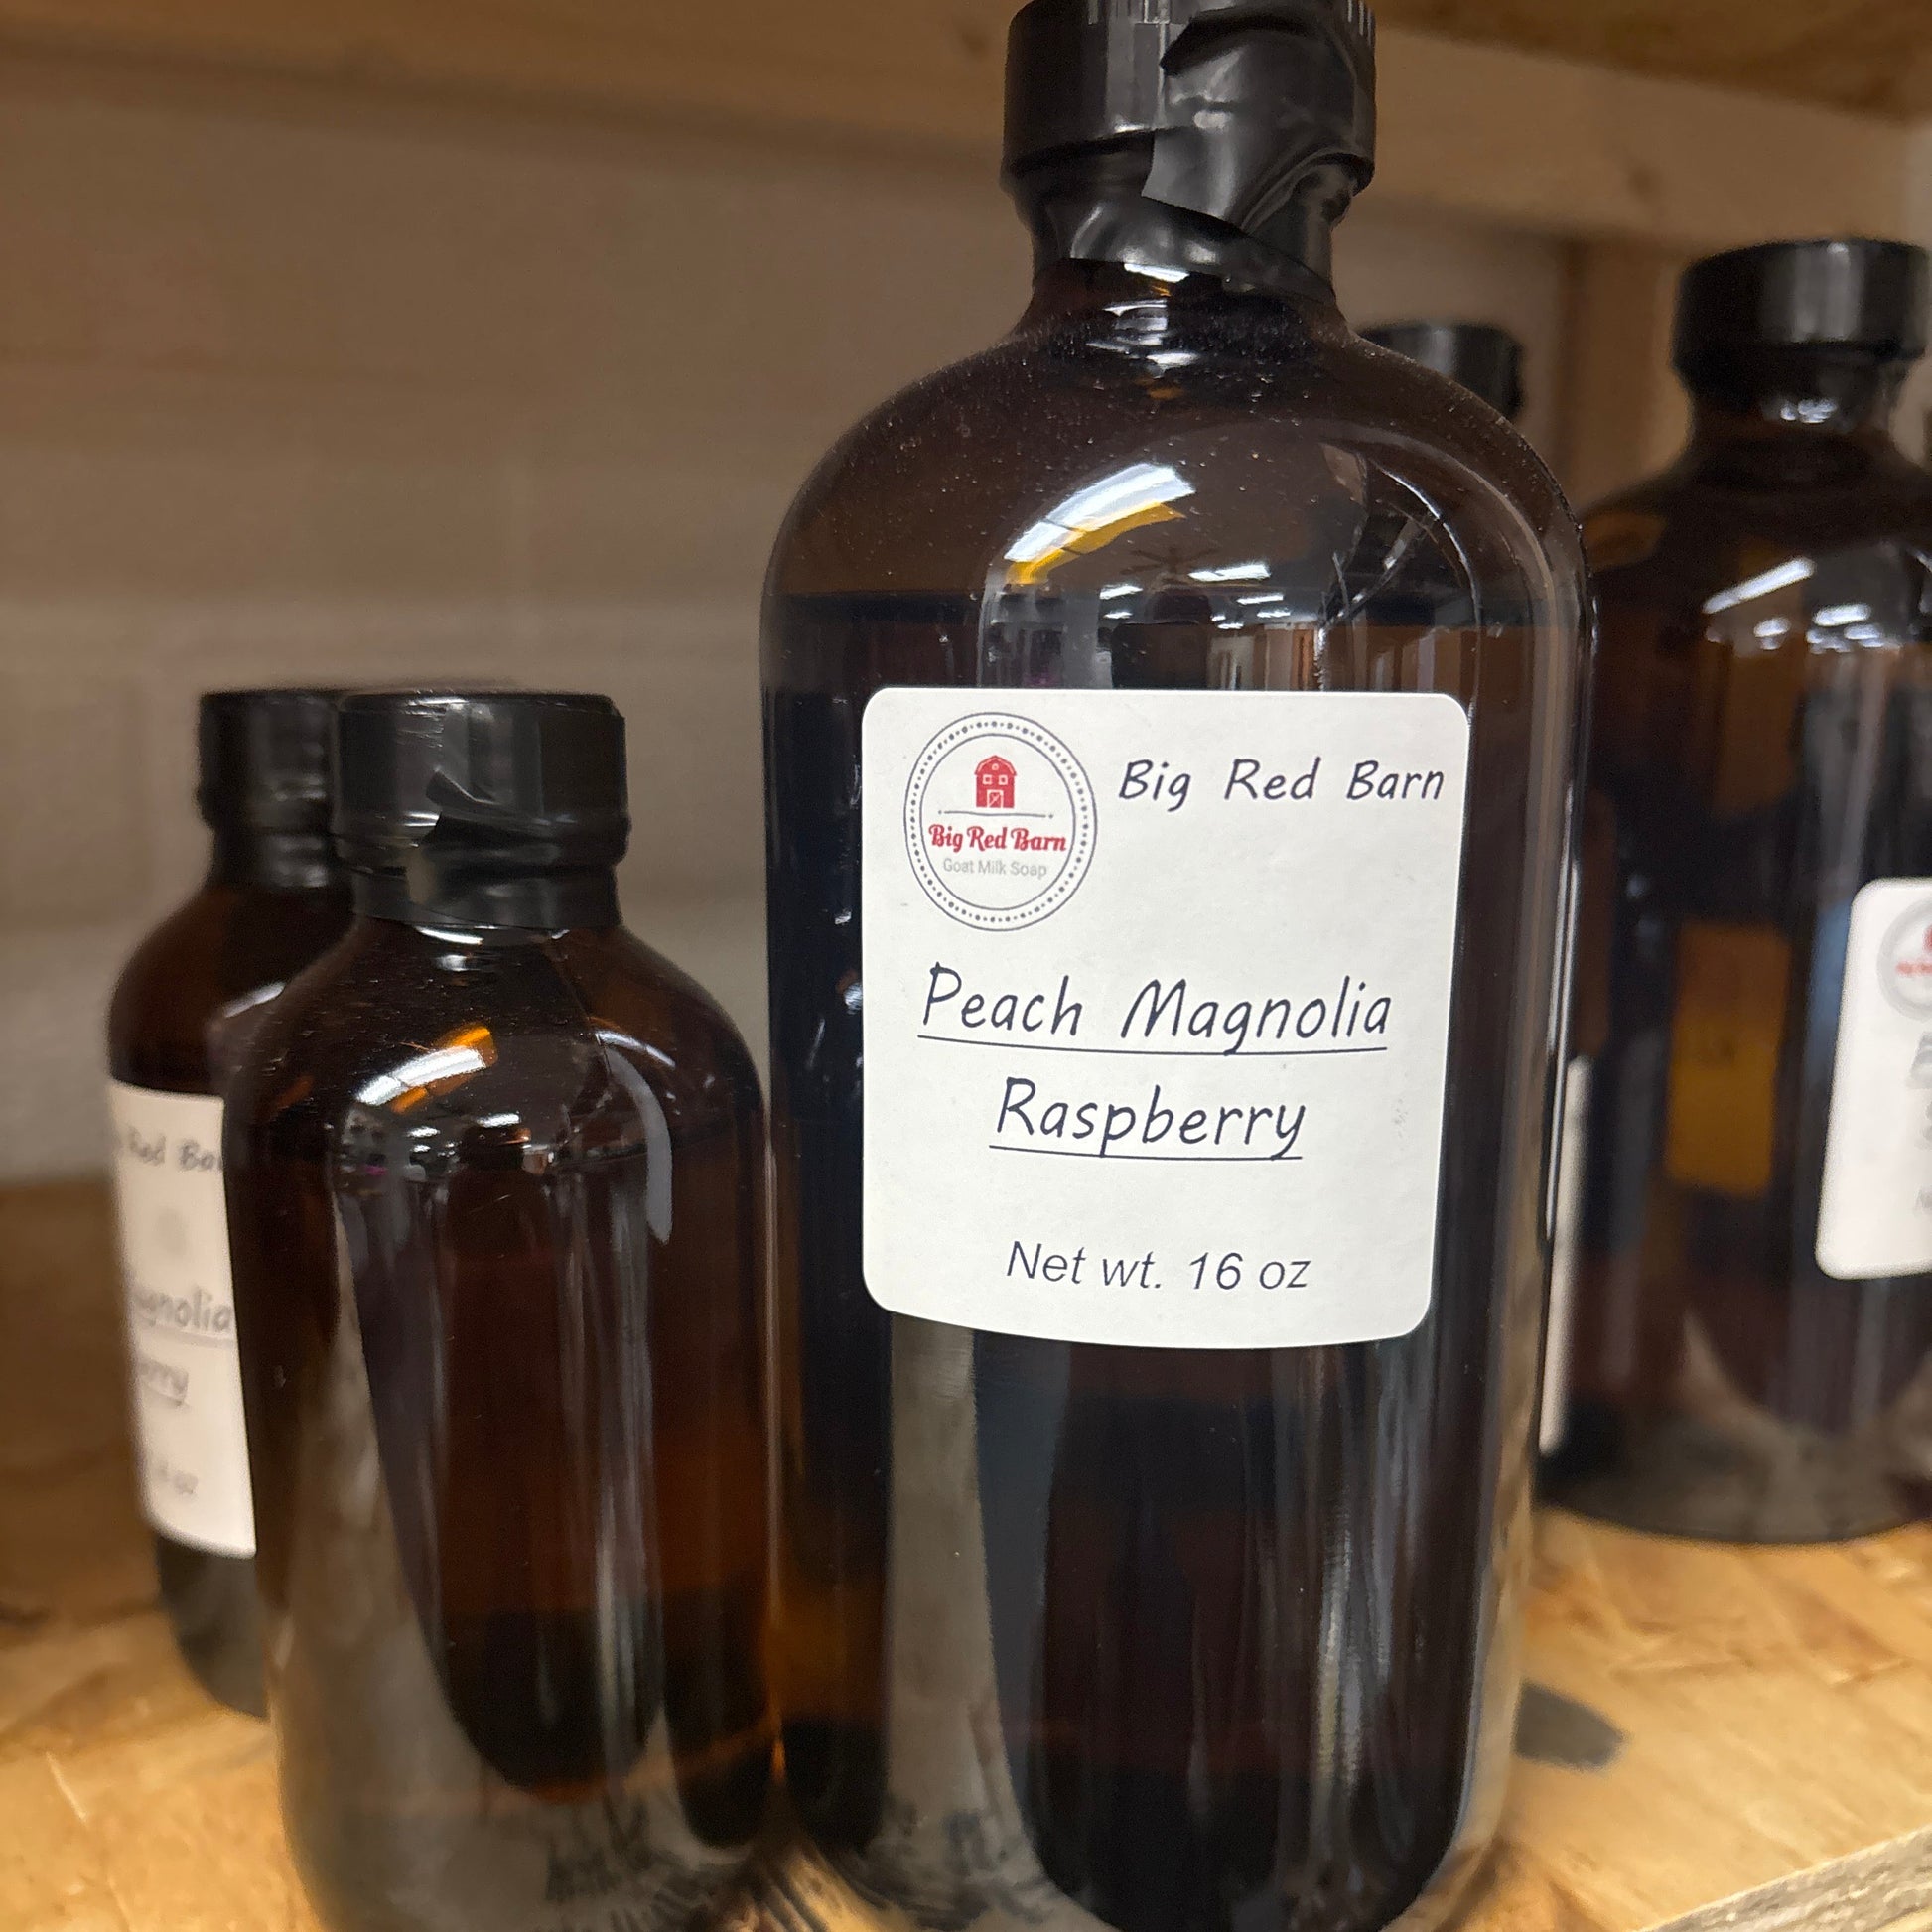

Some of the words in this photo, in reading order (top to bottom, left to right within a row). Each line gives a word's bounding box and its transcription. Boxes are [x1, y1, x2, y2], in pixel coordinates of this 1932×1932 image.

[1118, 759, 1191, 811] Big
[1223, 757, 1321, 802] Red
[1344, 759, 1445, 802] Barn
[928, 823, 964, 853] Big
[966, 825, 1008, 851] Red
[1010, 827, 1067, 852] Barn
[943, 858, 975, 874] Goat
[978, 860, 1007, 876] Milk
[1010, 861, 1048, 880] Soap
[922, 961, 1082, 1038] Peach
[1120, 975, 1393, 1056] Magnolia
[996, 1076, 1307, 1160] Raspberry
[1006, 1240, 1086, 1285] Net
[1102, 1249, 1164, 1291] wt.
[1187, 1251, 1242, 1291] 16
[1259, 1259, 1311, 1291] oz
